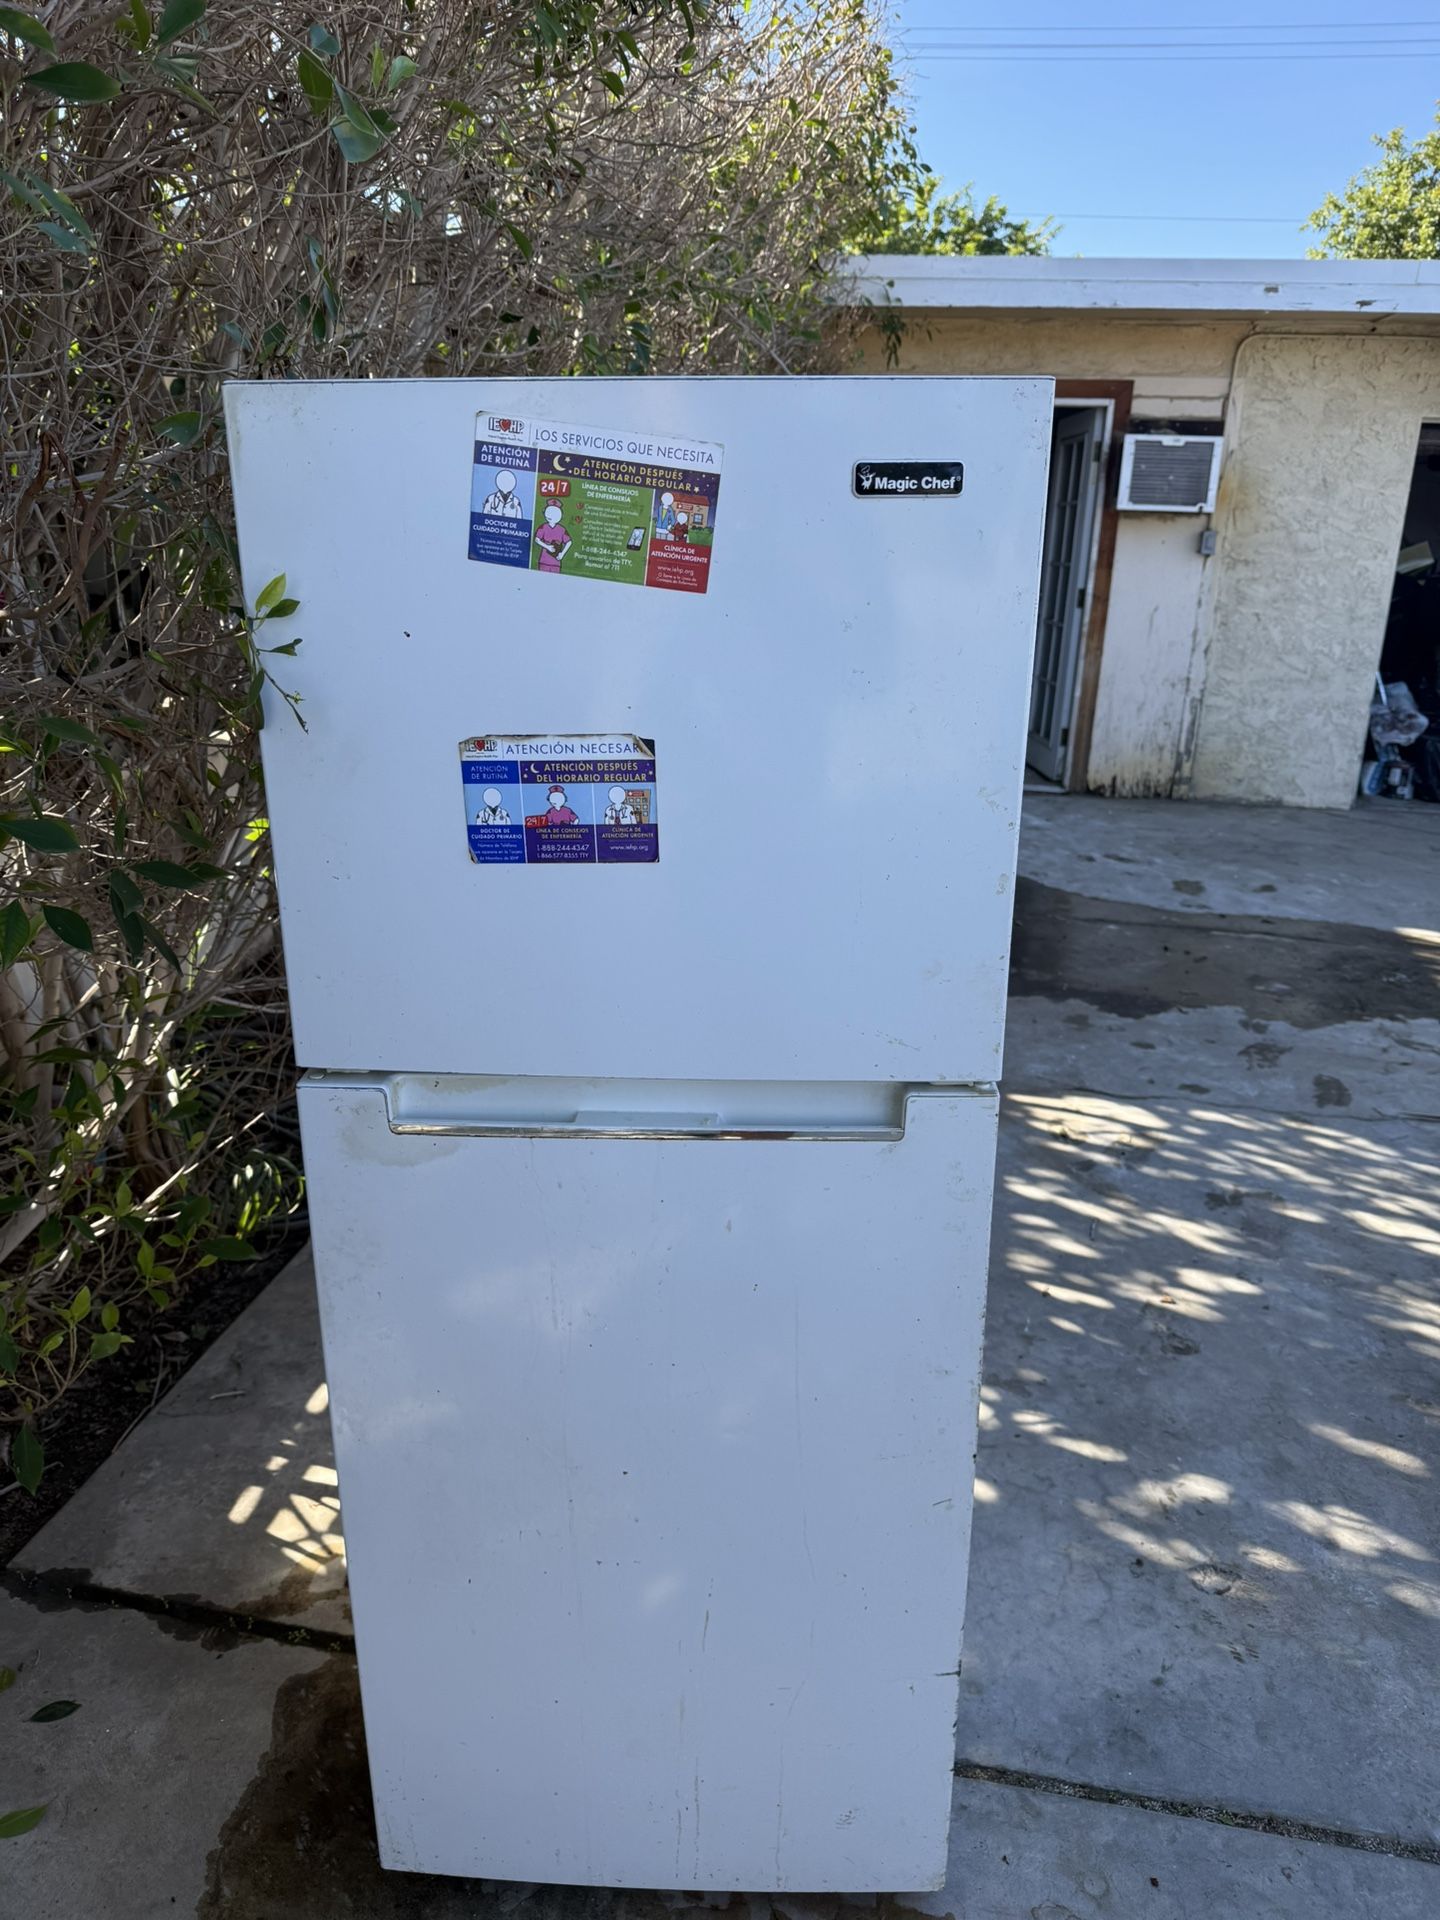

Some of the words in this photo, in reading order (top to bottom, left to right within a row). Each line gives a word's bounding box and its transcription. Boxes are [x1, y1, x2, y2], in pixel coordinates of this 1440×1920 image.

[481, 444, 530, 459] ATENCIÓN
[535, 429, 558, 443] LOS
[561, 432, 623, 452] SERVICIOS
[627, 441, 653, 456] QUE
[656, 445, 715, 464] NECESITA
[481, 454, 492, 463] DE
[495, 456, 530, 468] RUTINA
[583, 459, 636, 474] ATENCIÓN
[640, 466, 683, 480] DESPUÉS
[573, 468, 591, 478] DEL
[594, 470, 642, 484] HORARIO
[645, 477, 691, 492] REGULAR
[874, 476, 918, 492] Magic
[581, 482, 599, 491] LÍNEA
[608, 487, 639, 496] CONSEJOS
[595, 492, 631, 503] ENFERMERÍA
[485, 519, 508, 528] DOCTOR
[472, 524, 500, 533] CUIDADO
[500, 528, 529, 538] PRIMARIO
[664, 544, 686, 554] CLÍNICA
[687, 547, 695, 555] DE
[651, 551, 681, 560] ATENCIÓN
[681, 555, 708, 564] URGENTE
[657, 565, 695, 577] www.iehp.org
[506, 741, 574, 755] ATENCIÓN
[580, 743, 641, 754] NECESAR
[470, 765, 508, 773] ATENCIÓN
[544, 761, 593, 772] ATENCIÓN
[597, 760, 638, 771] DESPUÉS
[536, 774, 552, 783] DEL
[556, 773, 600, 783] HORARIO
[604, 772, 647, 782] REGULAR
[609, 843, 649, 852] www.iehp.org
